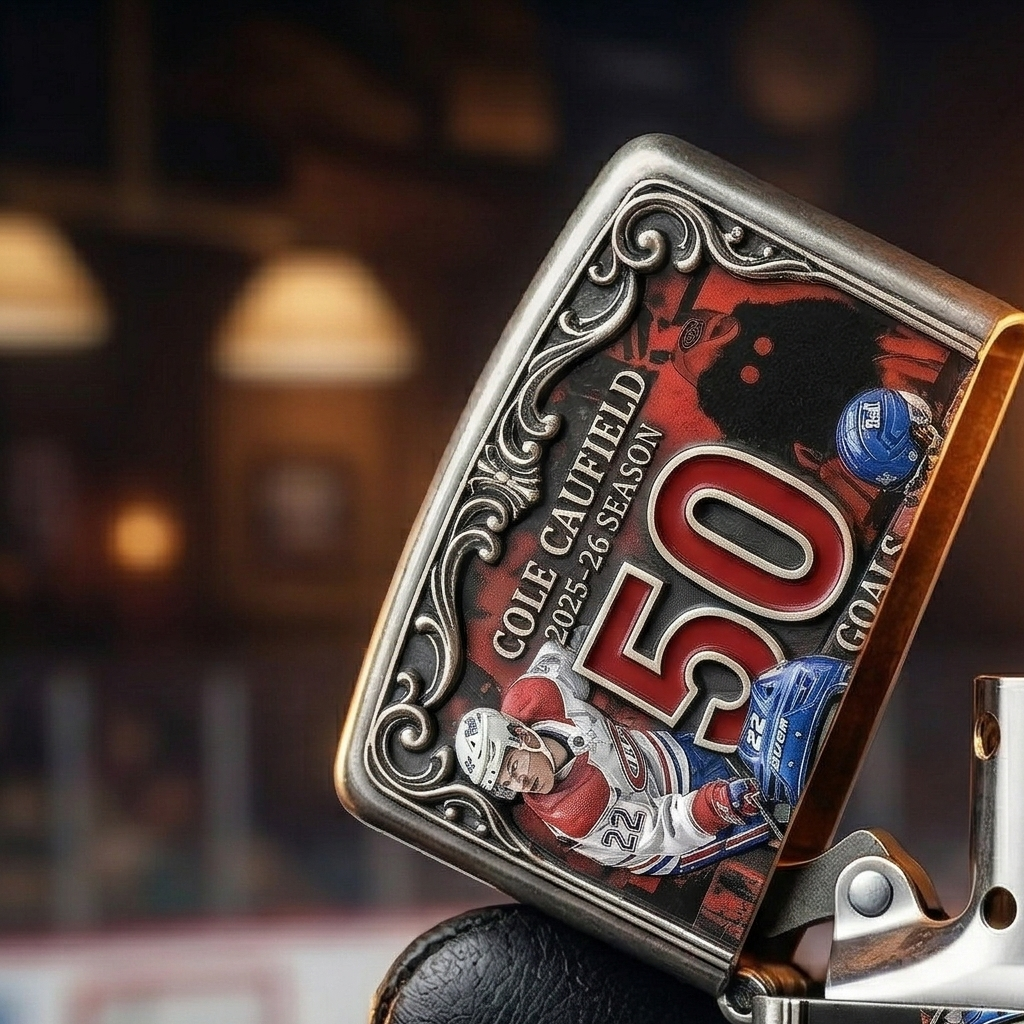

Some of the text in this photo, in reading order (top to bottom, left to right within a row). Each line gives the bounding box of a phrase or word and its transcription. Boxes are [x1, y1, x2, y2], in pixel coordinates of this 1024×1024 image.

[492, 369, 647, 661] COLE CAUFIELD
[544, 421, 665, 647] 2025-26 SEASON
[572, 445, 854, 753] 50
[601, 807, 647, 853] 22
[746, 712, 767, 752] 22
